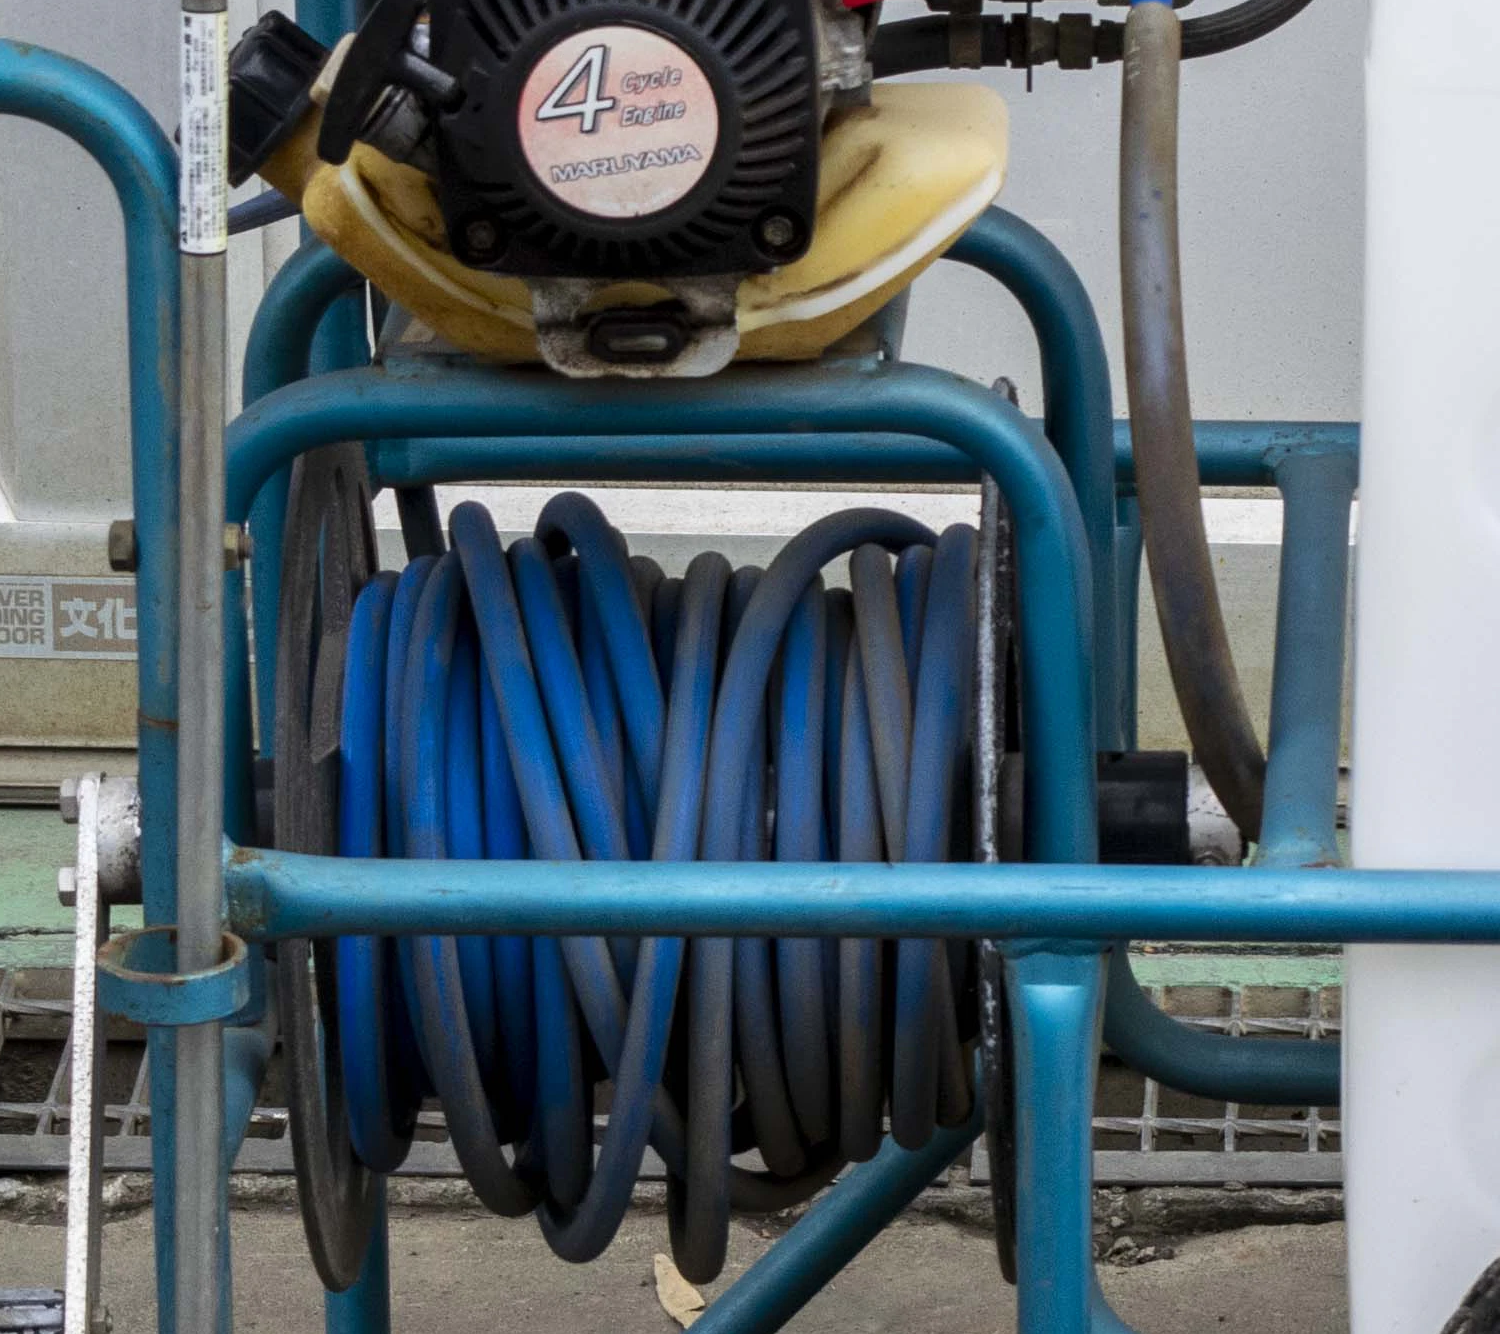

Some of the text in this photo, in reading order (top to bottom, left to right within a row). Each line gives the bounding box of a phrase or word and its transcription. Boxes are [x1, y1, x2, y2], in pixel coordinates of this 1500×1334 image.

[536, 44, 683, 134] 4 Cycle
[620, 100, 686, 127] Engine
[552, 144, 703, 183] MARUYAMA
